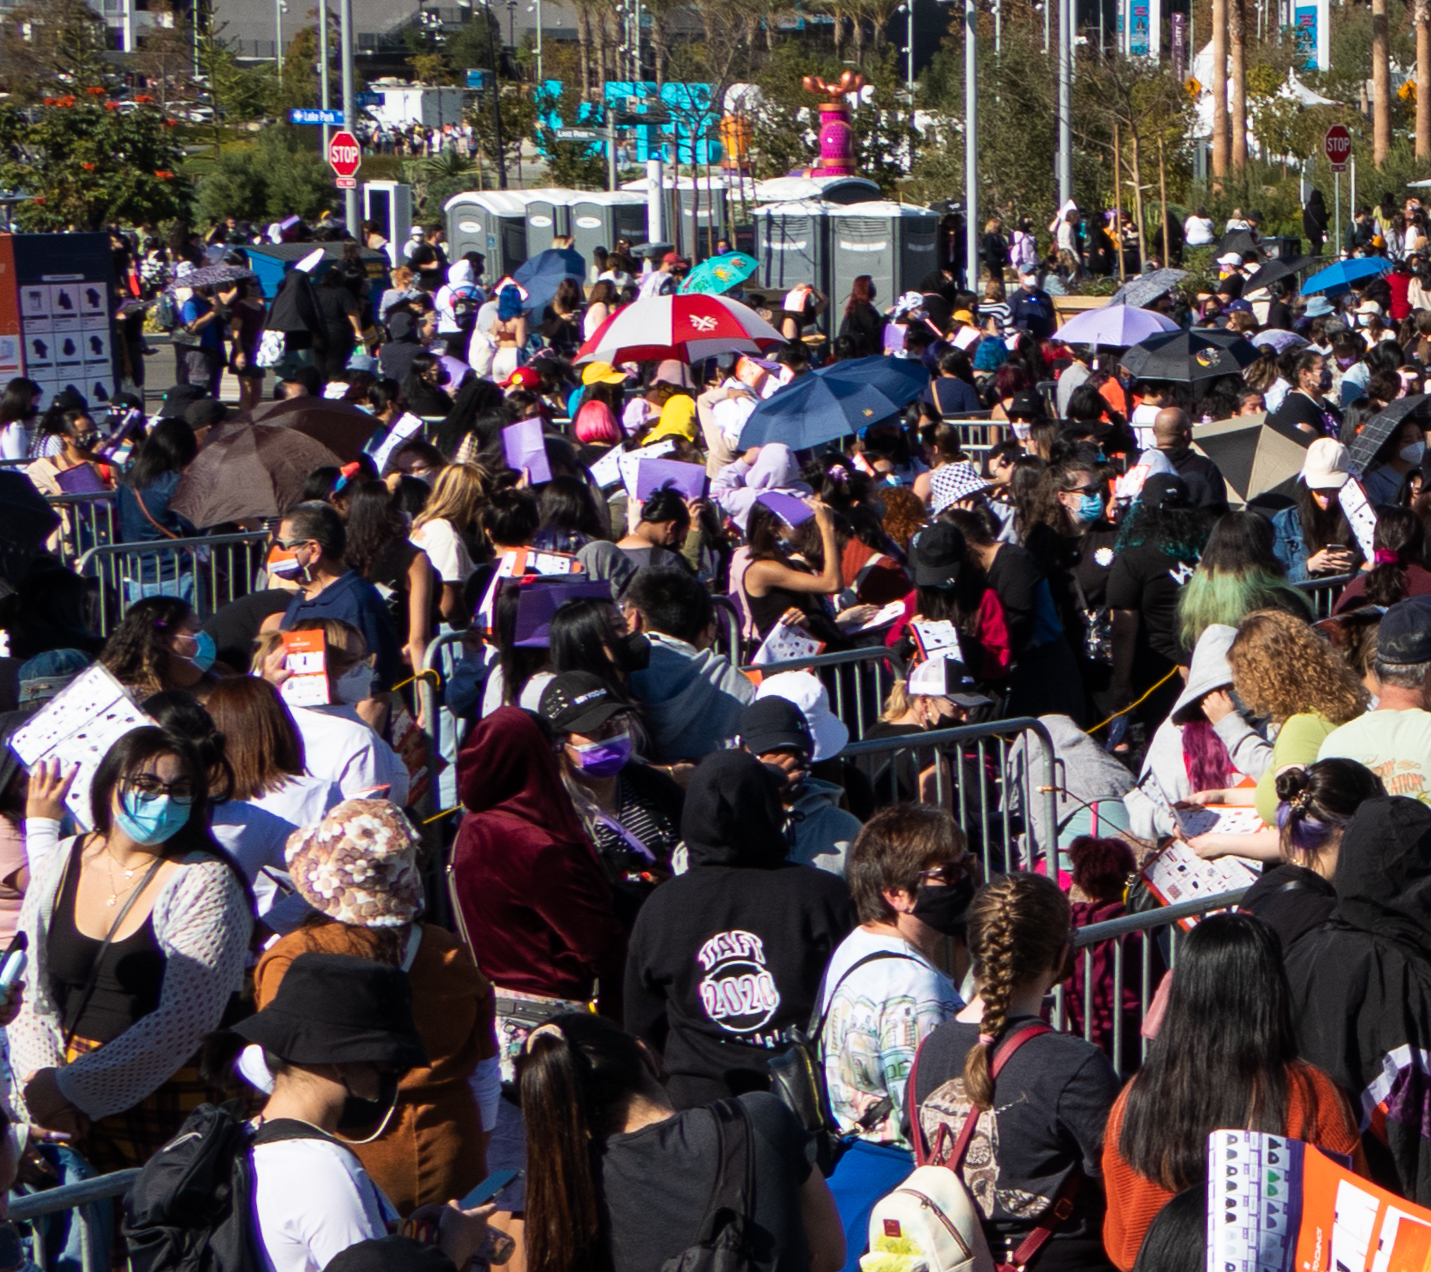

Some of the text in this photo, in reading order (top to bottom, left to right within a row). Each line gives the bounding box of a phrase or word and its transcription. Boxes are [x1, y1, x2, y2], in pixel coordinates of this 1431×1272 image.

[332, 146, 359, 164] STOP
[1327, 137, 1350, 152] STOP
[698, 930, 766, 970] TAFT
[700, 970, 780, 1018] 2020
